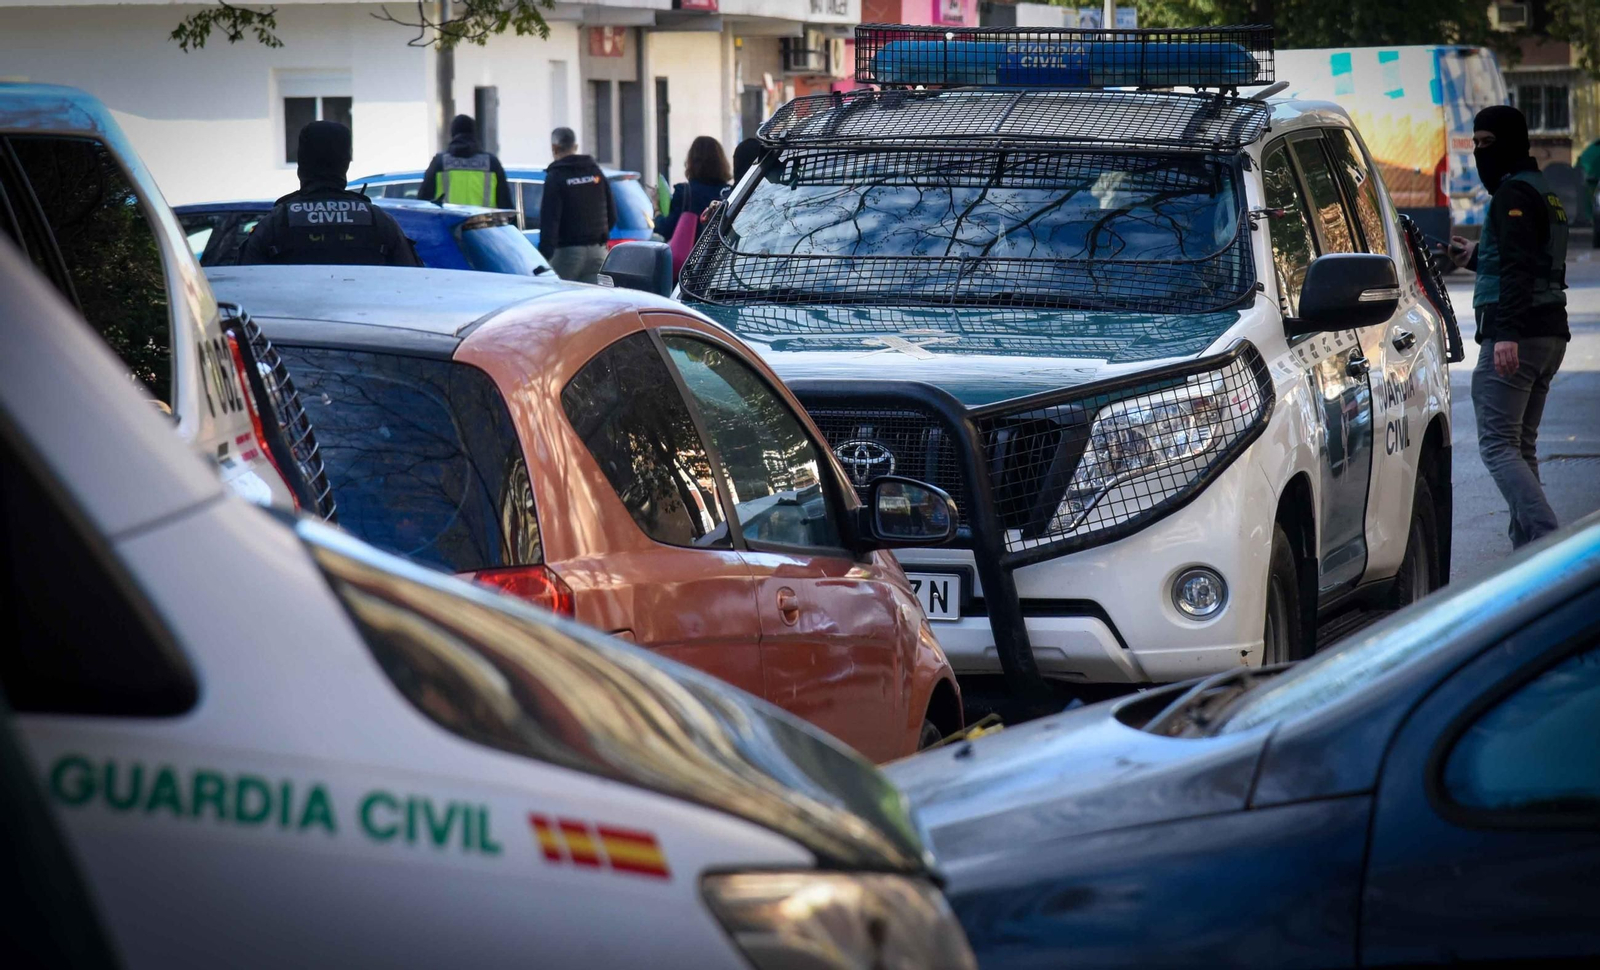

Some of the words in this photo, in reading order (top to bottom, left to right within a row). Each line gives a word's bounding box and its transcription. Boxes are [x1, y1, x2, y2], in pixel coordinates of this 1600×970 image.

[1006, 45, 1086, 56] GUARDIA
[1020, 56, 1067, 68] CIVIL
[566, 175, 595, 186] POLICIA
[290, 201, 369, 212] GUARDIA
[307, 211, 354, 223] CIVIL
[1386, 415, 1410, 455] CIVIL
[50, 753, 336, 834] GUARDIA
[358, 789, 504, 854] CIVIL
